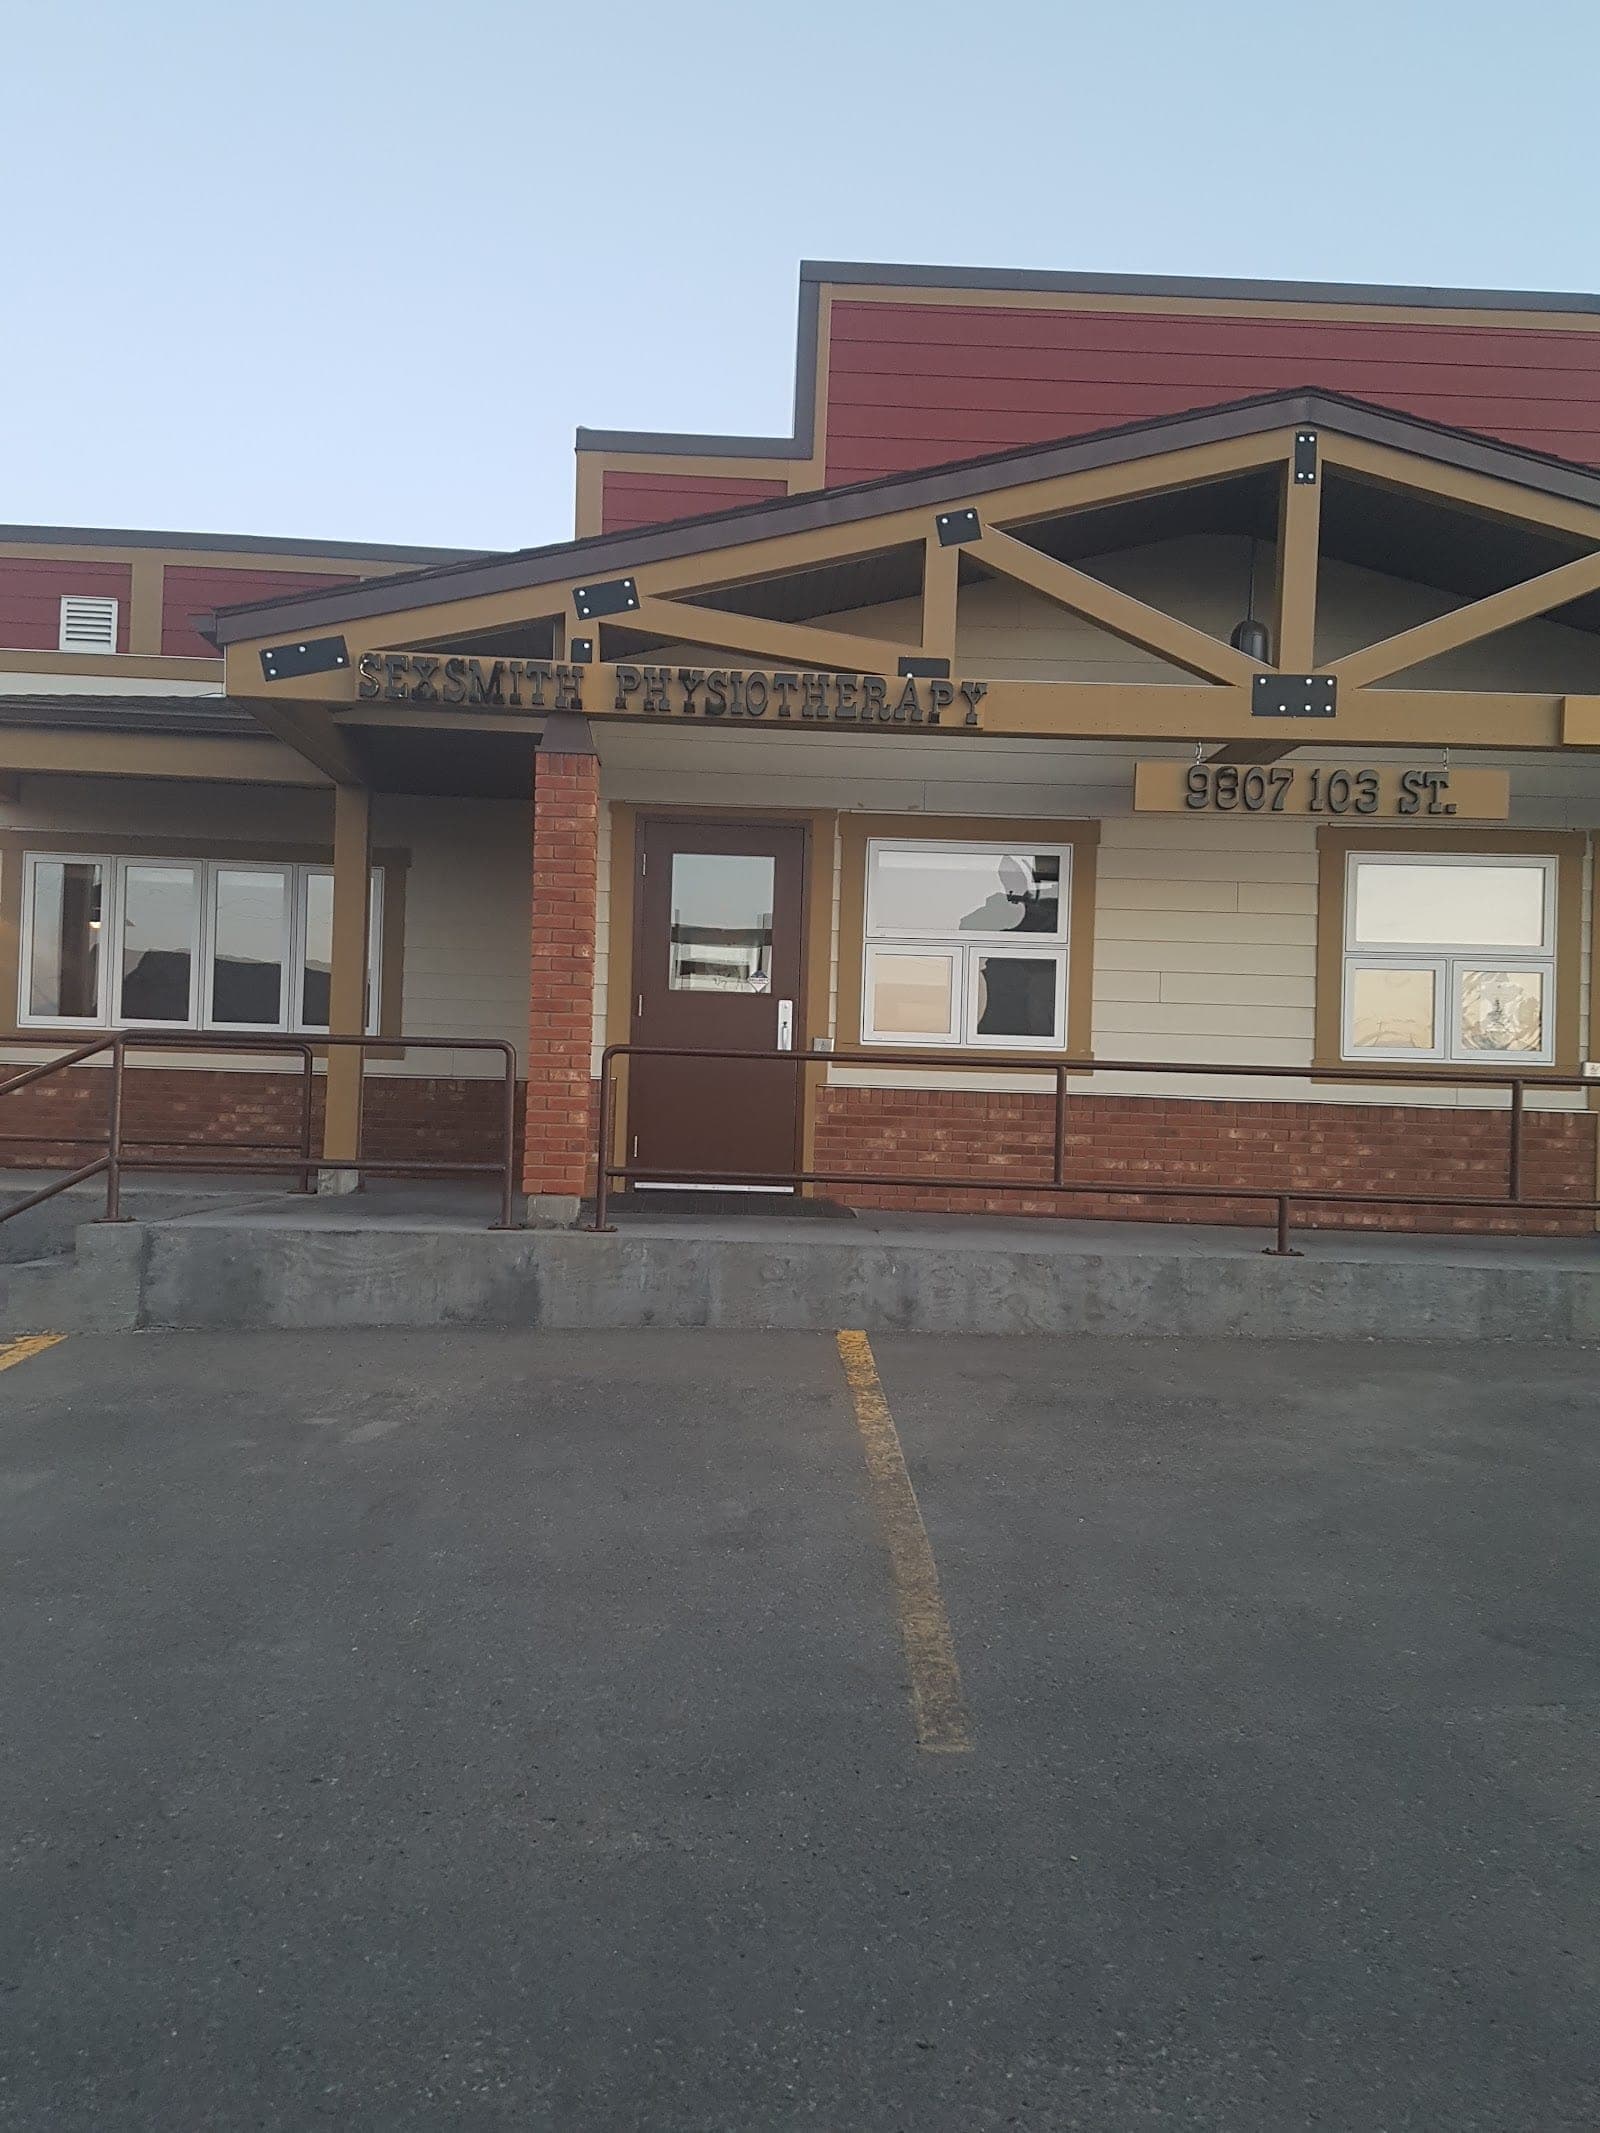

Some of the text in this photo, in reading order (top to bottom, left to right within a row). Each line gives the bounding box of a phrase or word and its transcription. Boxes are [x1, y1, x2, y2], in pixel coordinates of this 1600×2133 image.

[359, 653, 988, 726] SEXSMITH PHYSIOTHERAPY
[1186, 765, 1458, 814] 9807 103 ST.
